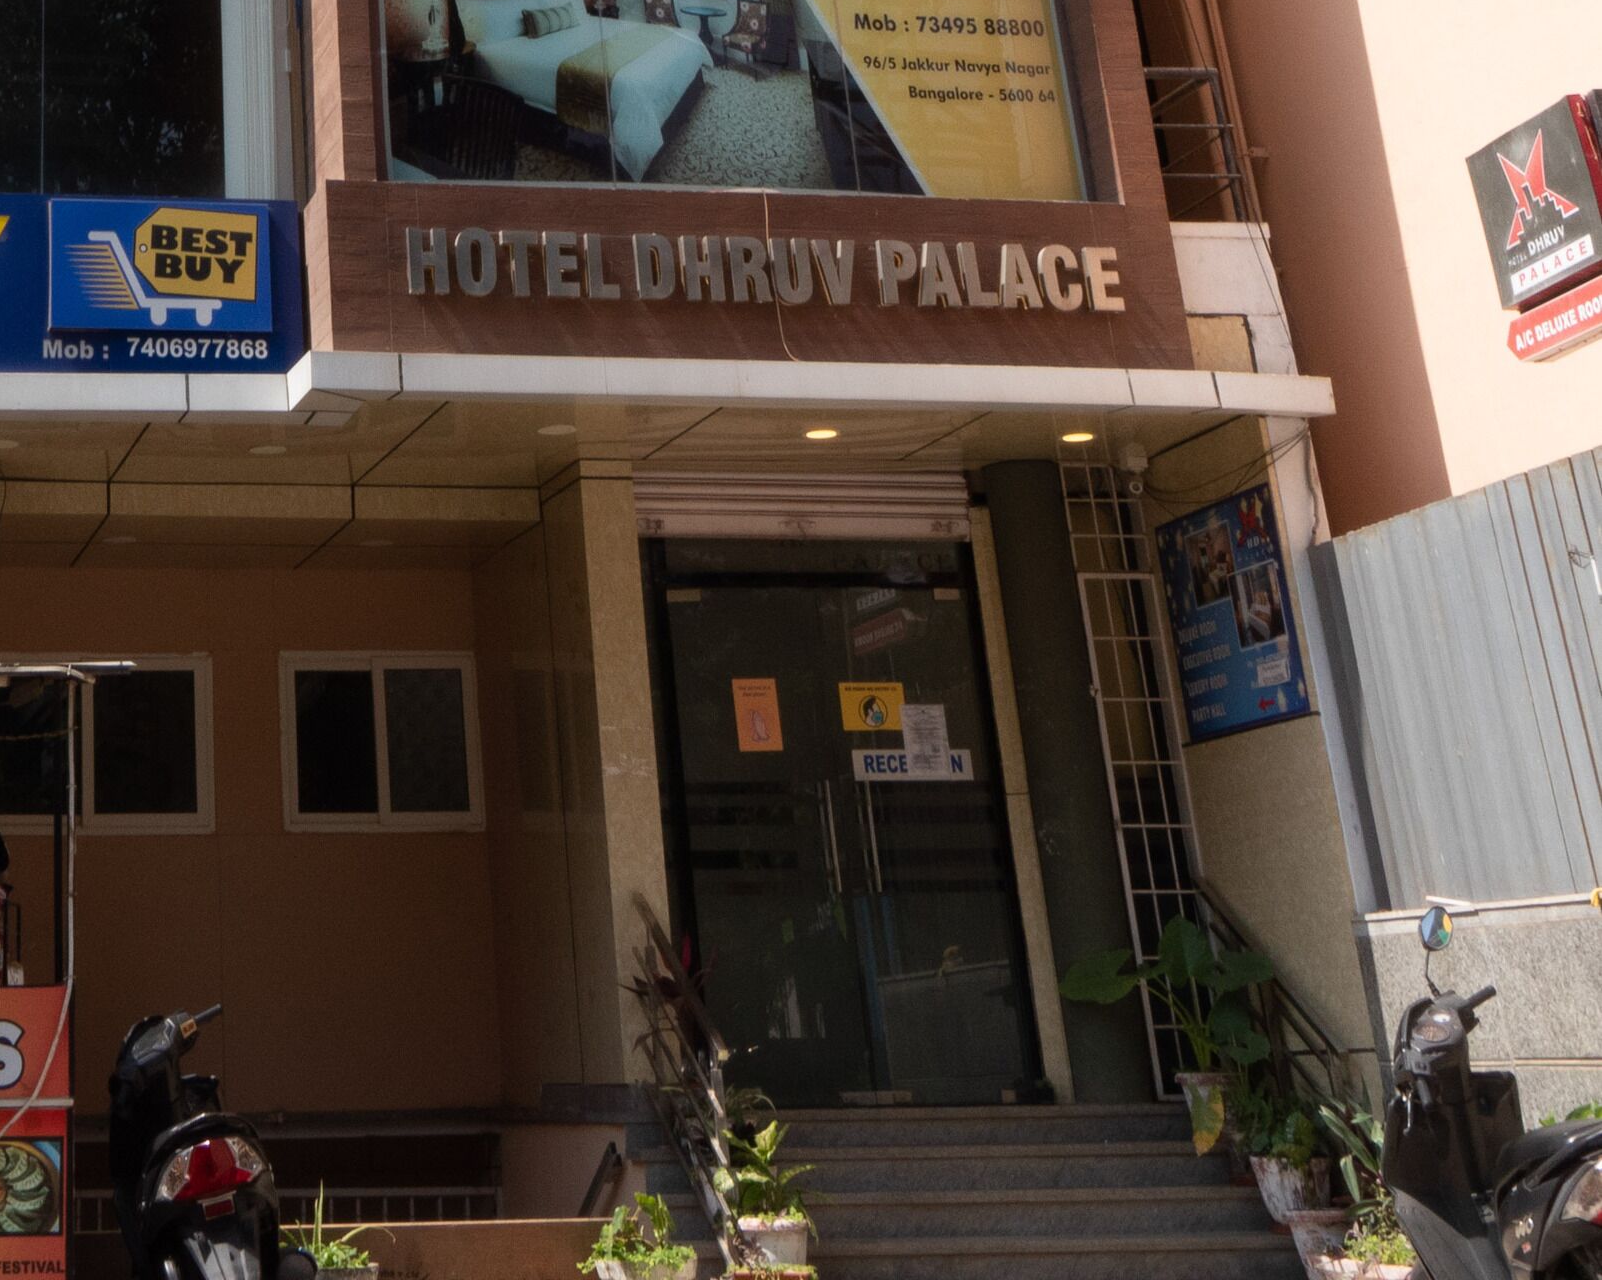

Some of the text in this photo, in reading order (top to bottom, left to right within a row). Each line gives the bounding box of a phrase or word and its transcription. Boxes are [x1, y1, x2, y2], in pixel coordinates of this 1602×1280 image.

[854, 13, 896, 32] Mob
[916, 16, 978, 34] 73495
[984, 18, 1045, 37] 88800
[863, 55, 1052, 78] 96/5 Jakkur Navya Nagar
[908, 85, 984, 103] Bangalore
[999, 88, 1034, 103] 5600
[1038, 89, 1055, 103] 64
[149, 224, 256, 257] BEST
[1527, 225, 1566, 257] DHRUV
[152, 252, 246, 284] BUY
[406, 226, 1126, 313] HOTEL DHRUV PALACE
[1519, 241, 1588, 287] PALACE
[1515, 297, 1602, 352] A/C DELUXE ROO
[42, 338, 95, 360] Mob
[126, 337, 270, 361] 7406977868
[864, 754, 963, 773] RECEN
